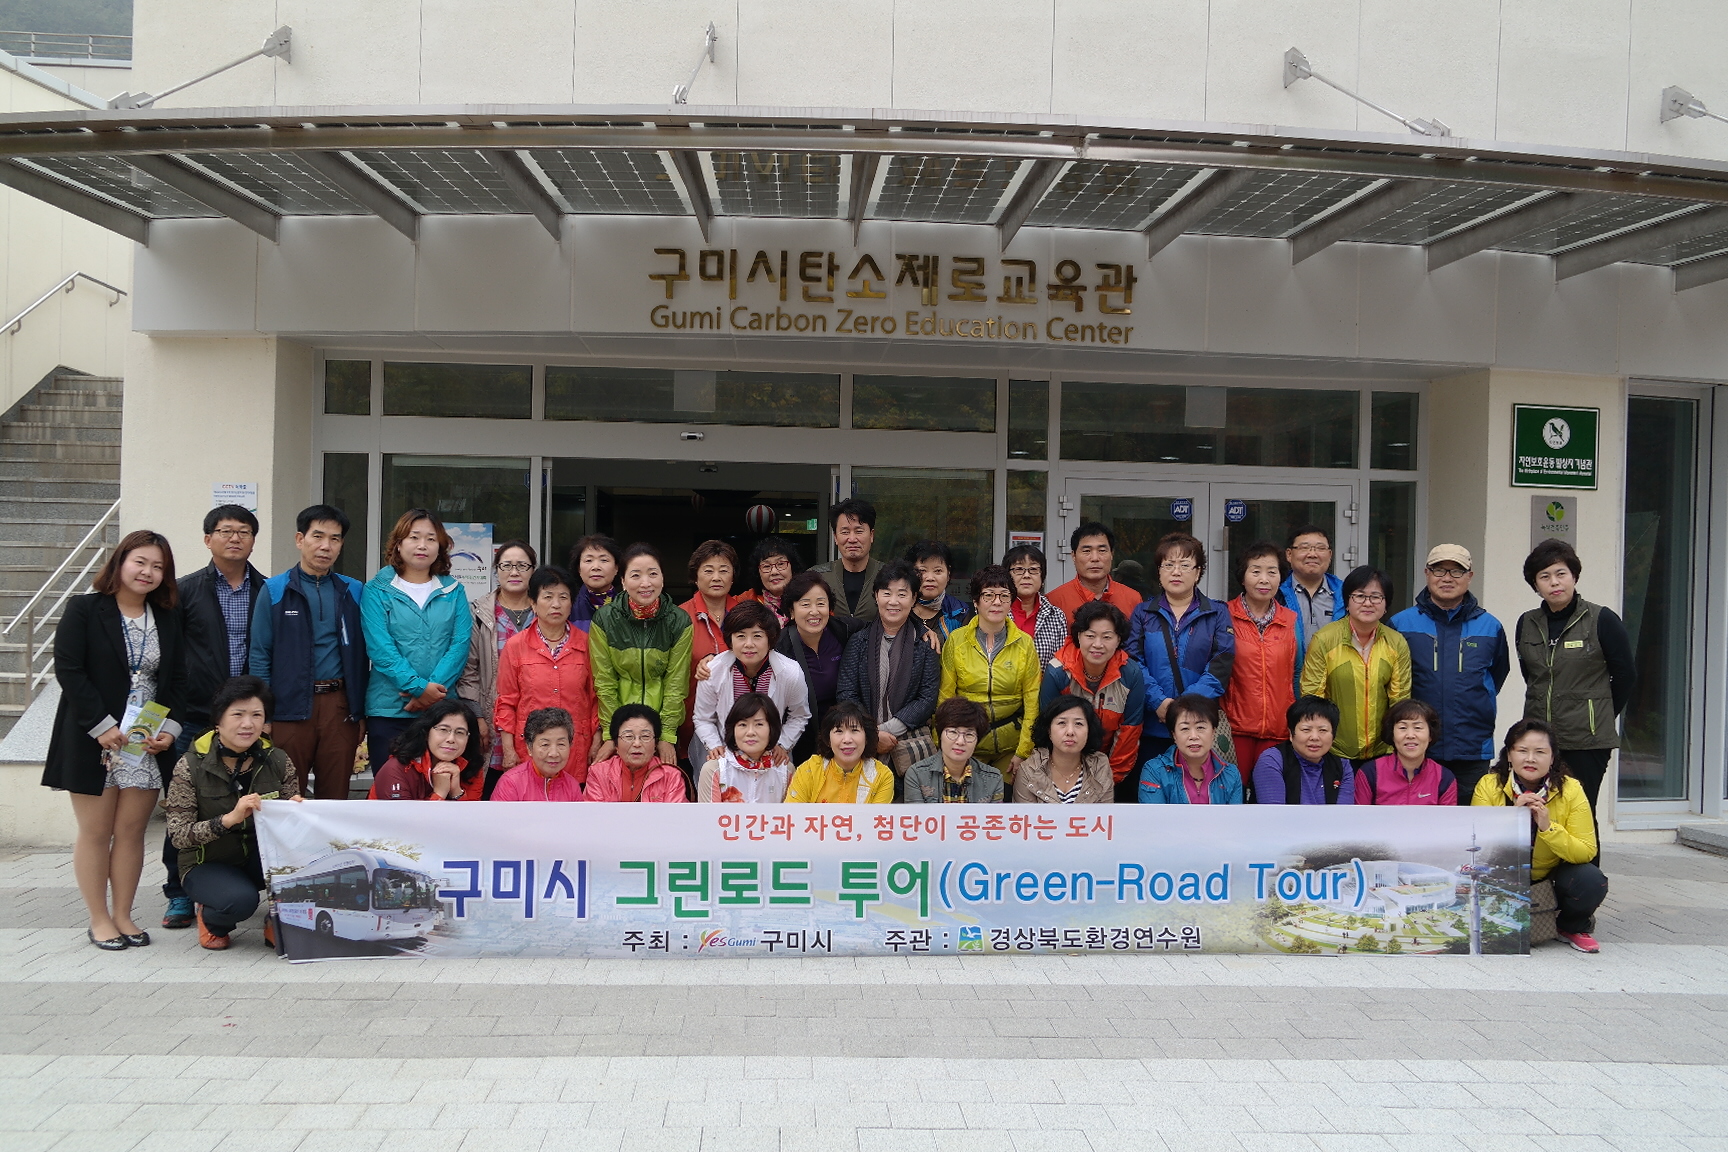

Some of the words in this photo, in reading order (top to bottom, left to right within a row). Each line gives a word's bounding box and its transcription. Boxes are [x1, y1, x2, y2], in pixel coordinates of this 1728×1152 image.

[648, 248, 1138, 315] 구미시탄소제로교육관
[650, 304, 722, 330] Gumi
[730, 306, 827, 331] Carbon
[835, 309, 896, 335] Zero
[905, 311, 1038, 340] Education
[1046, 316, 1134, 344] Center
[1173, 505, 1189, 514] ADT
[1228, 506, 1243, 515] ADT
[718, 814, 795, 841] 인간과
[804, 814, 862, 842] 자연,
[873, 814, 945, 842] 첨단이
[956, 814, 1057, 842] 공존하는
[1065, 814, 1113, 841] 도시
[438, 860, 587, 919] 구미시
[616, 860, 812, 918] 그린로드
[1248, 858, 1365, 908] Tour)
[622, 930, 669, 952] 주최
[761, 930, 832, 952] 구미시
[884, 929, 932, 952] 주관
[989, 926, 1202, 950] 경상북도환경연수원
